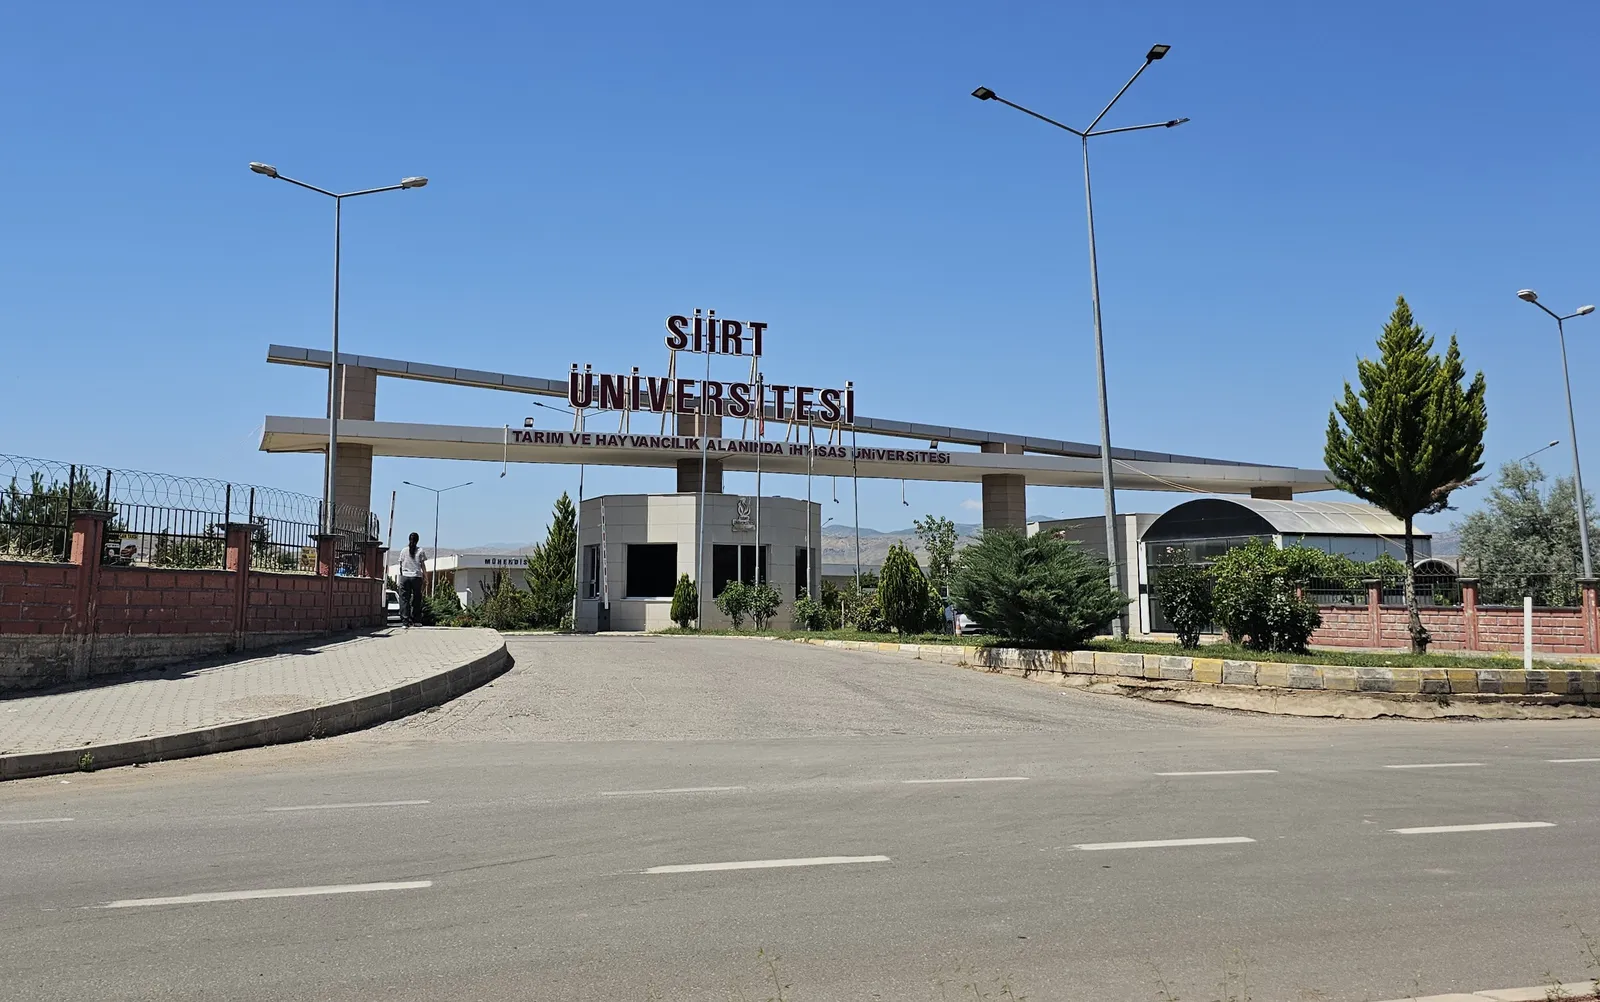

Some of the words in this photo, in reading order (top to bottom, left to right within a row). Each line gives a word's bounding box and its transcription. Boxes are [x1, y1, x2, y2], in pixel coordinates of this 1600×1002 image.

[664, 308, 768, 357] SİİRT
[568, 363, 855, 425] ÜNİVERSİTESİ
[512, 430, 564, 444] TARIM
[569, 433, 591, 445] VE
[706, 439, 783, 454] ALANINDA
[851, 447, 950, 464] ÜNİVERSİTESİ
